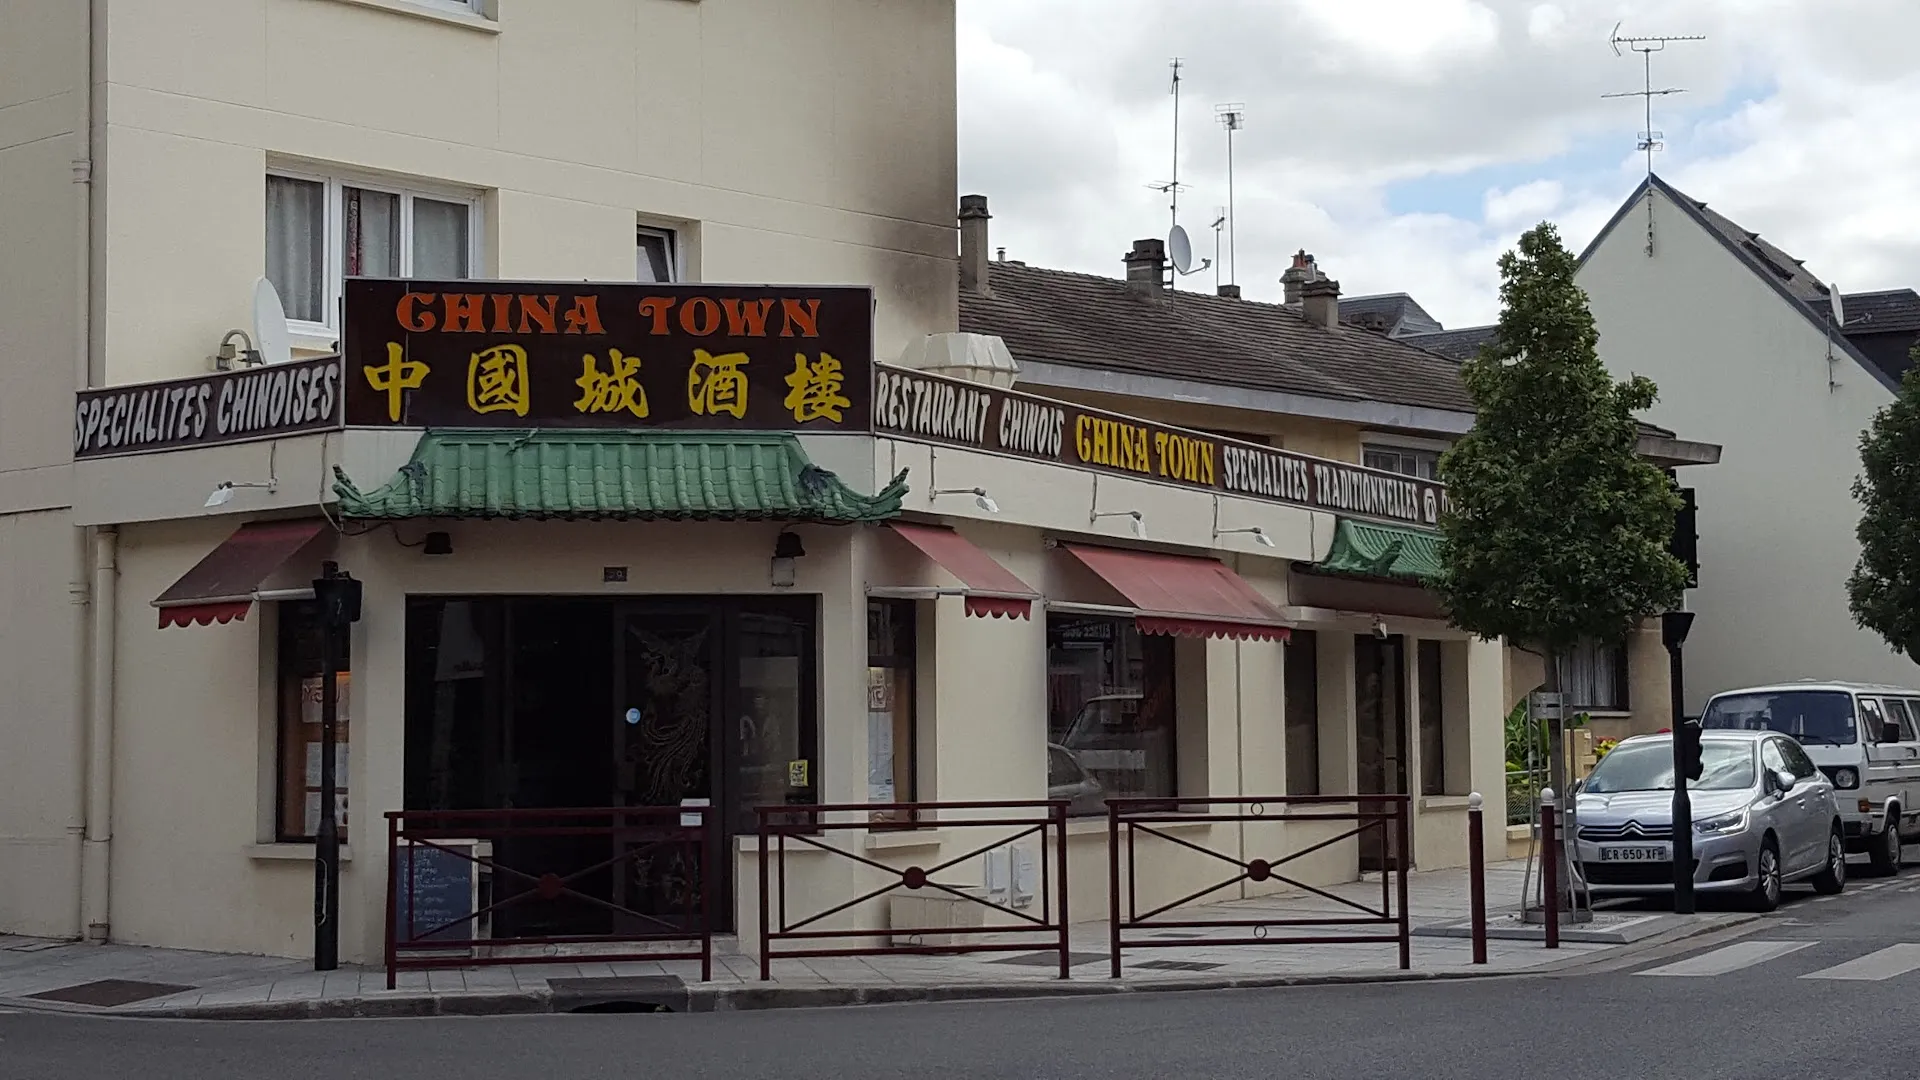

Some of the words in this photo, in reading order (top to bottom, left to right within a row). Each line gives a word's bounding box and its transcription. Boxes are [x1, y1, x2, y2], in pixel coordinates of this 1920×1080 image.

[396, 292, 607, 335] CHINA
[639, 296, 820, 338] TOWN
[75, 382, 212, 453] SPECIALITES
[217, 362, 339, 434] CHINOISES
[363, 343, 852, 422] 中國城酒樓
[876, 371, 991, 444] RESTAURANT
[1000, 397, 1065, 456] CHINOIS
[1075, 414, 1150, 474] CHINA
[1155, 431, 1214, 485] TOWN
[1223, 445, 1309, 502] SPECIALITES
[1315, 463, 1419, 521] TRADITIONNELLES
